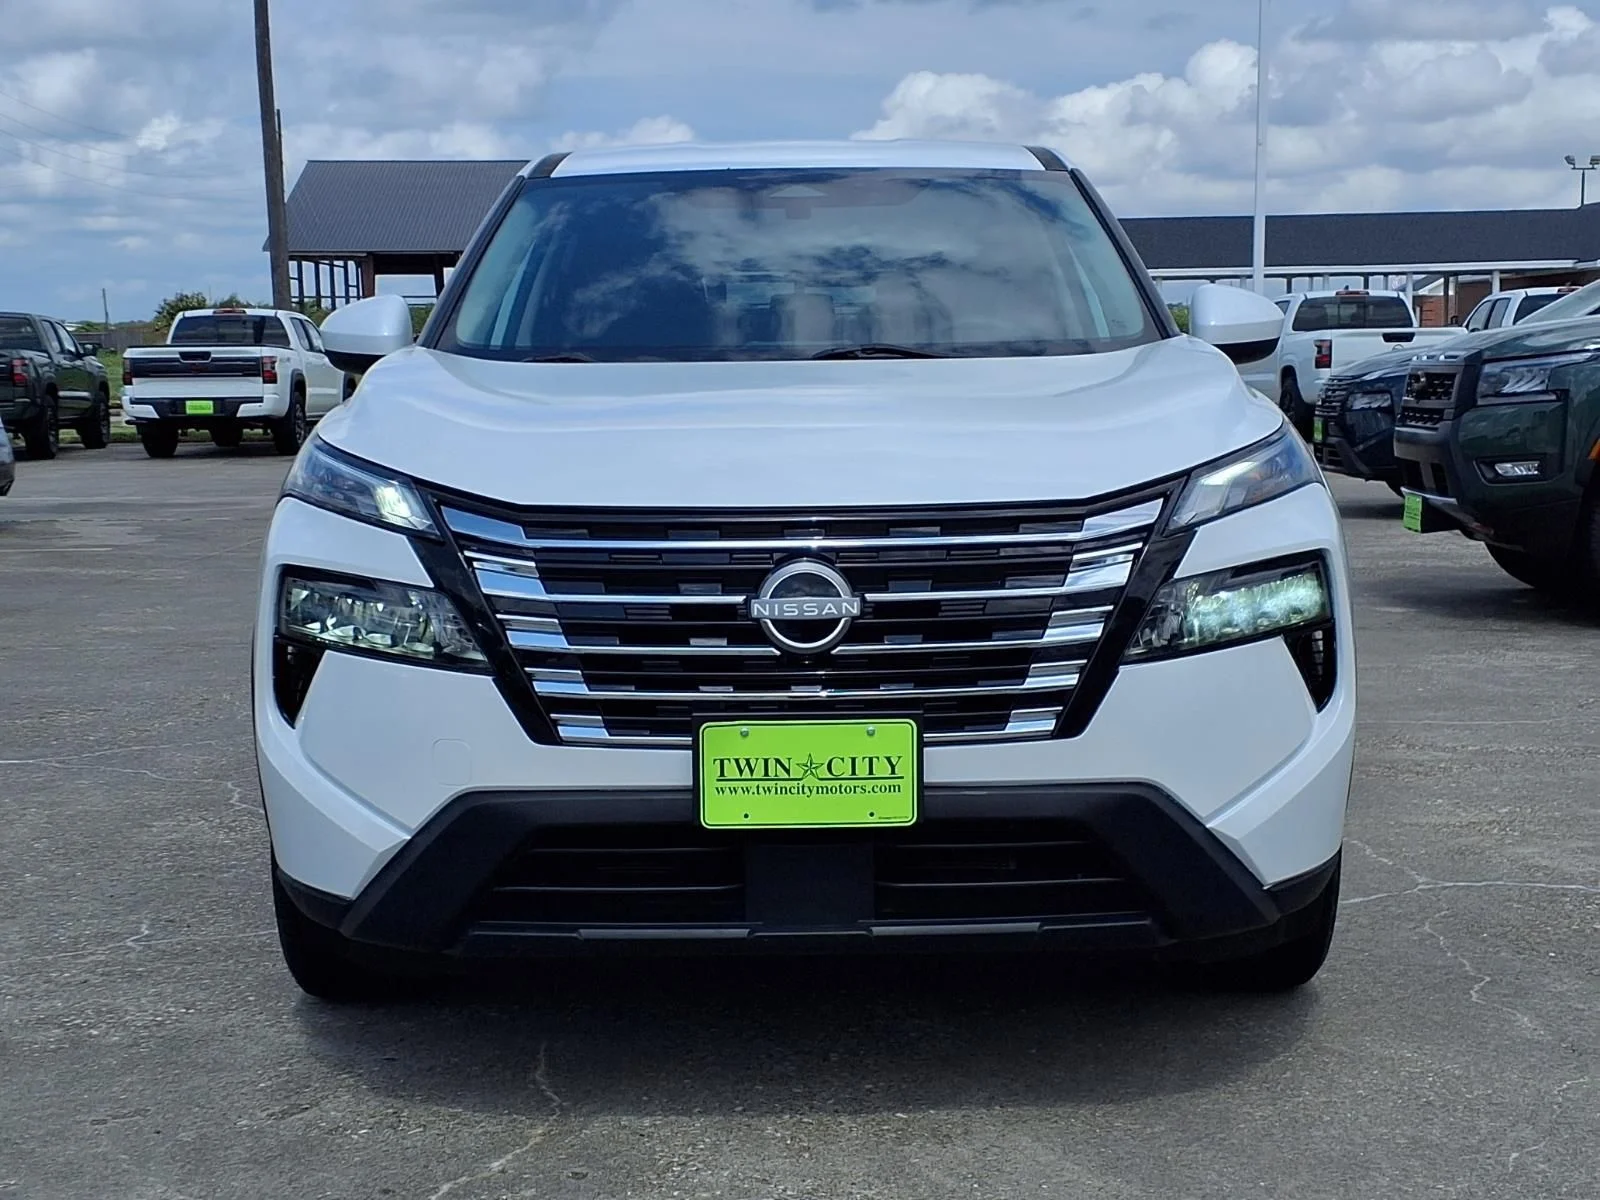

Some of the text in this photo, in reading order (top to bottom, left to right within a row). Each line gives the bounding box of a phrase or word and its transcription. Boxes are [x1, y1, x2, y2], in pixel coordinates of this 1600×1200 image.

[753, 601, 858, 616] NISSAN
[713, 755, 904, 778] TWIN CITY
[715, 782, 902, 798] www.twincitymotors.com
